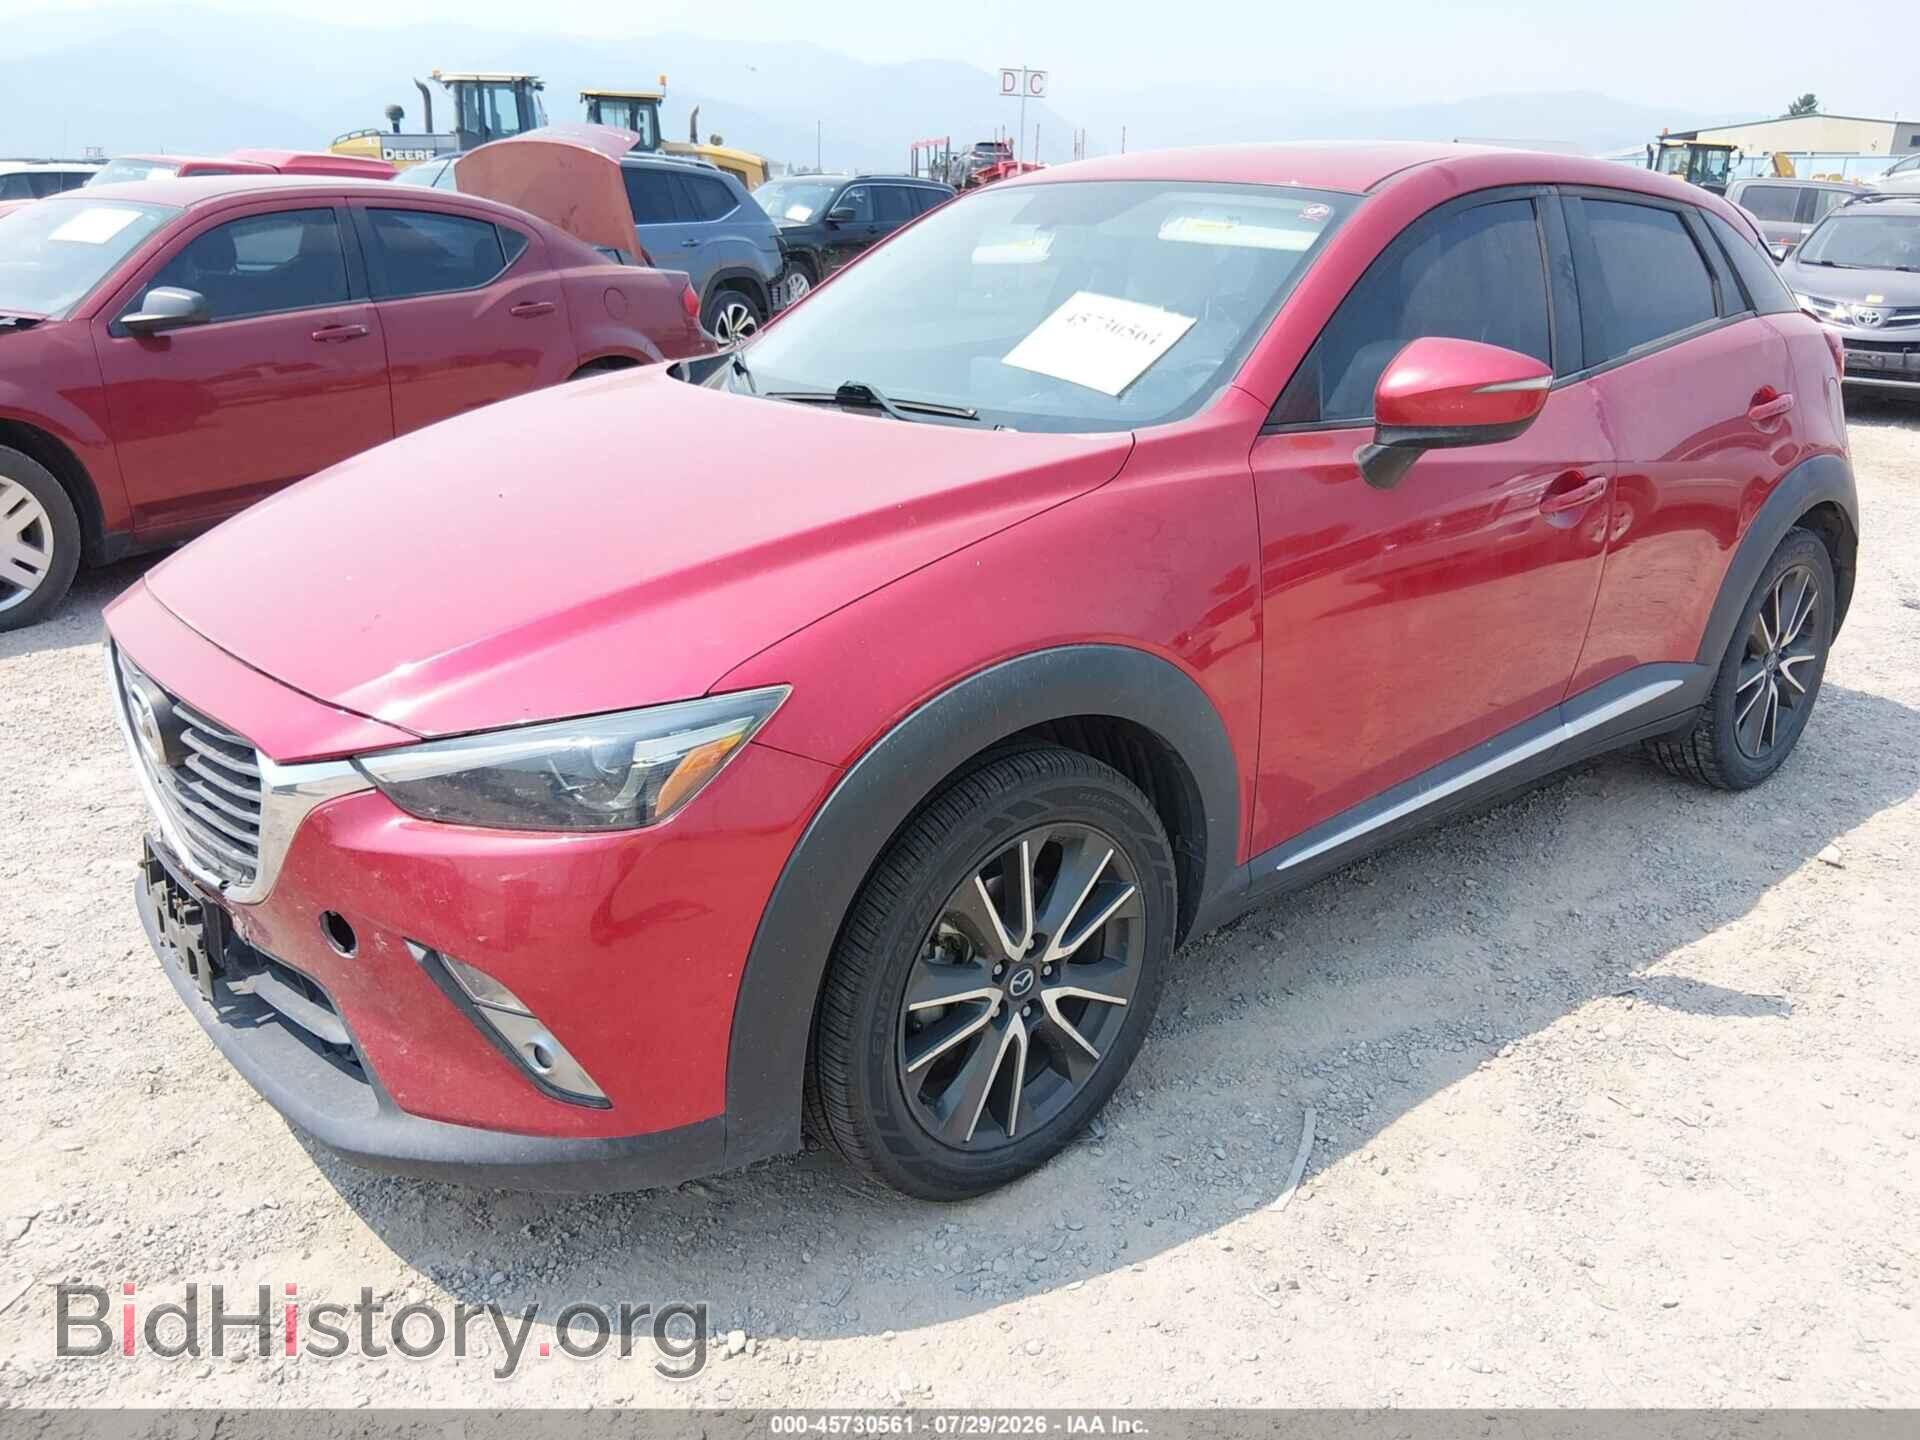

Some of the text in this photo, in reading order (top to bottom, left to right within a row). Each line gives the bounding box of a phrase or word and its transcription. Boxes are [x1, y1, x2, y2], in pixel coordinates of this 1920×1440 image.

[1003, 72, 1044, 94] D C
[383, 149, 435, 160] DEERE
